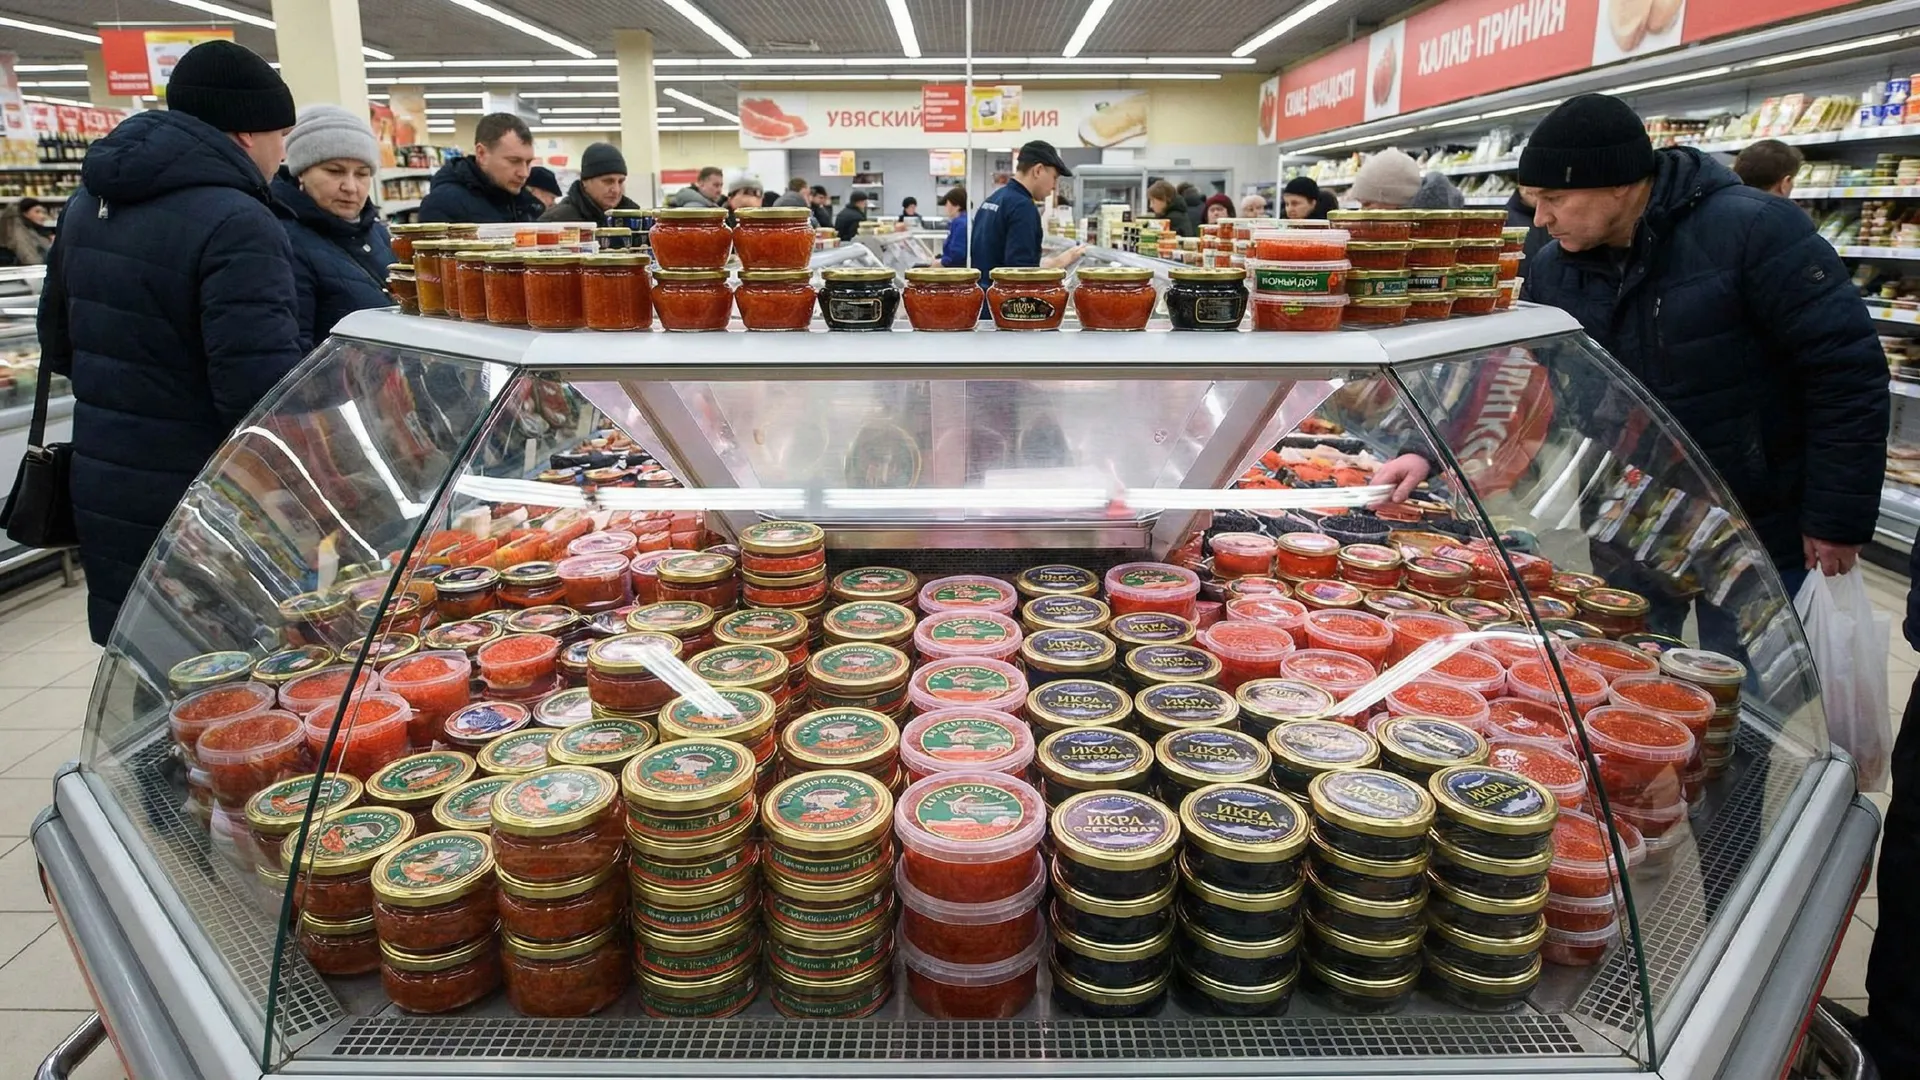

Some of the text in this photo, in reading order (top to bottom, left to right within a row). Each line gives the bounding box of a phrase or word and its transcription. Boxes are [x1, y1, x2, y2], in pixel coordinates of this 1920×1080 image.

[1071, 745, 1122, 755] ИКРА
[1188, 744, 1240, 757] ИКРА
[1465, 781, 1512, 801] ИКРА
[1216, 803, 1274, 822] ИКРА
[1086, 815, 1144, 826] ИКРА
